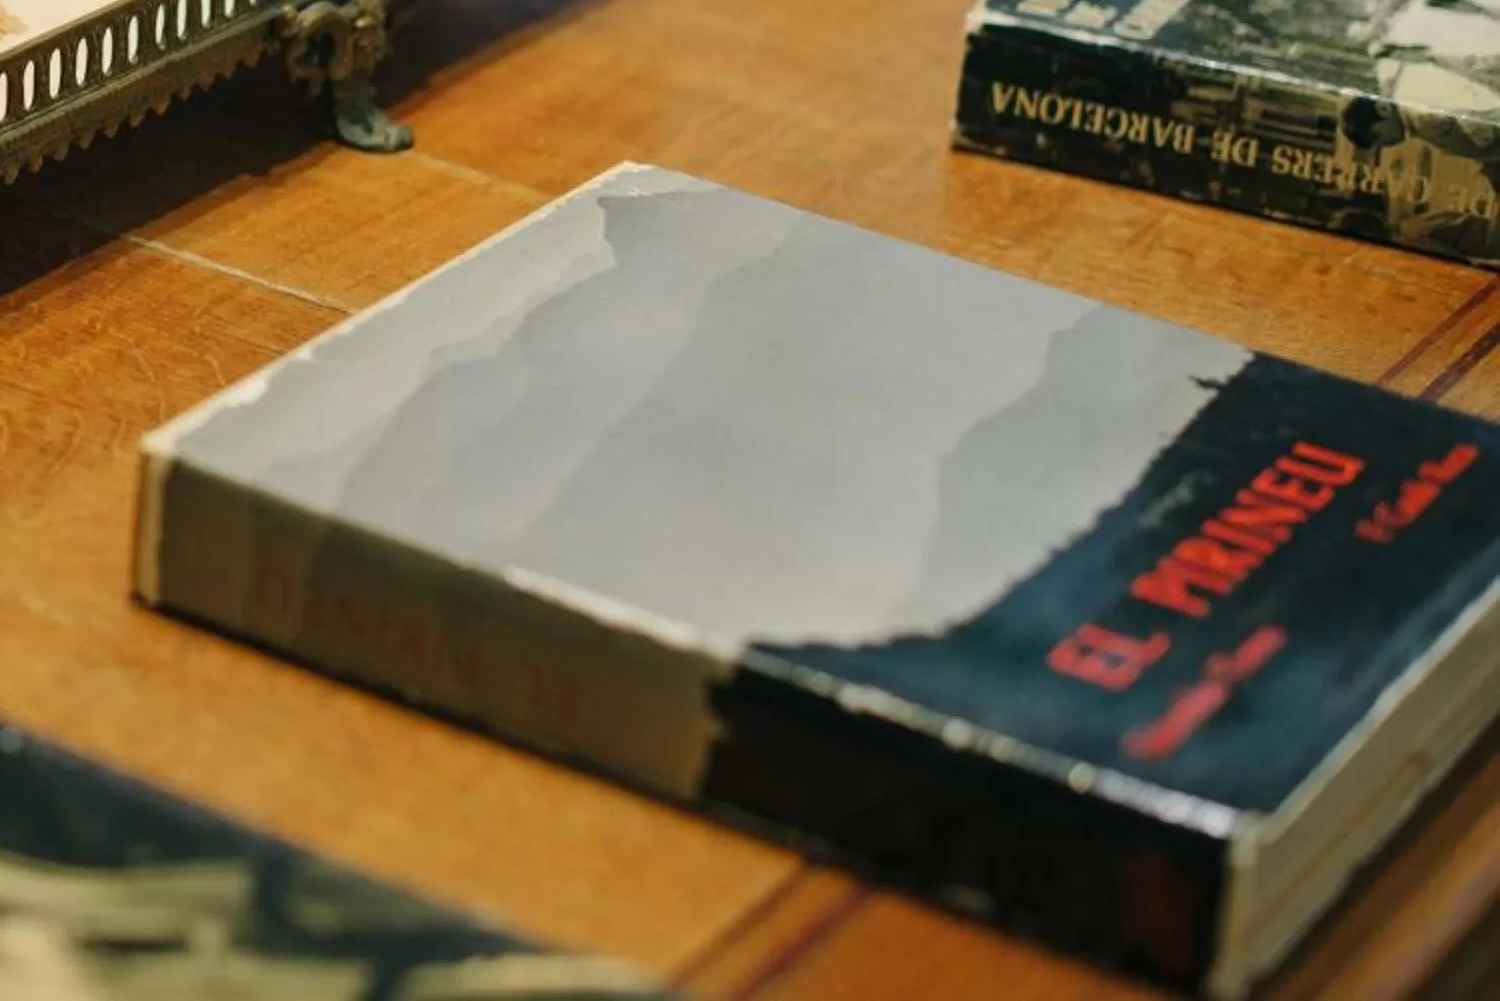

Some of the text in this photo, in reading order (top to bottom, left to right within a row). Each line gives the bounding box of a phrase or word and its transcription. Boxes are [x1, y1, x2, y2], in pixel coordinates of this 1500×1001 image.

[991, 79, 1195, 155] BARCELONA
[1210, 125, 1260, 168] DE
[1270, 143, 1430, 204] CARRERS
[1044, 621, 1172, 692] EL
[1127, 438, 1366, 620] PIRINEU
